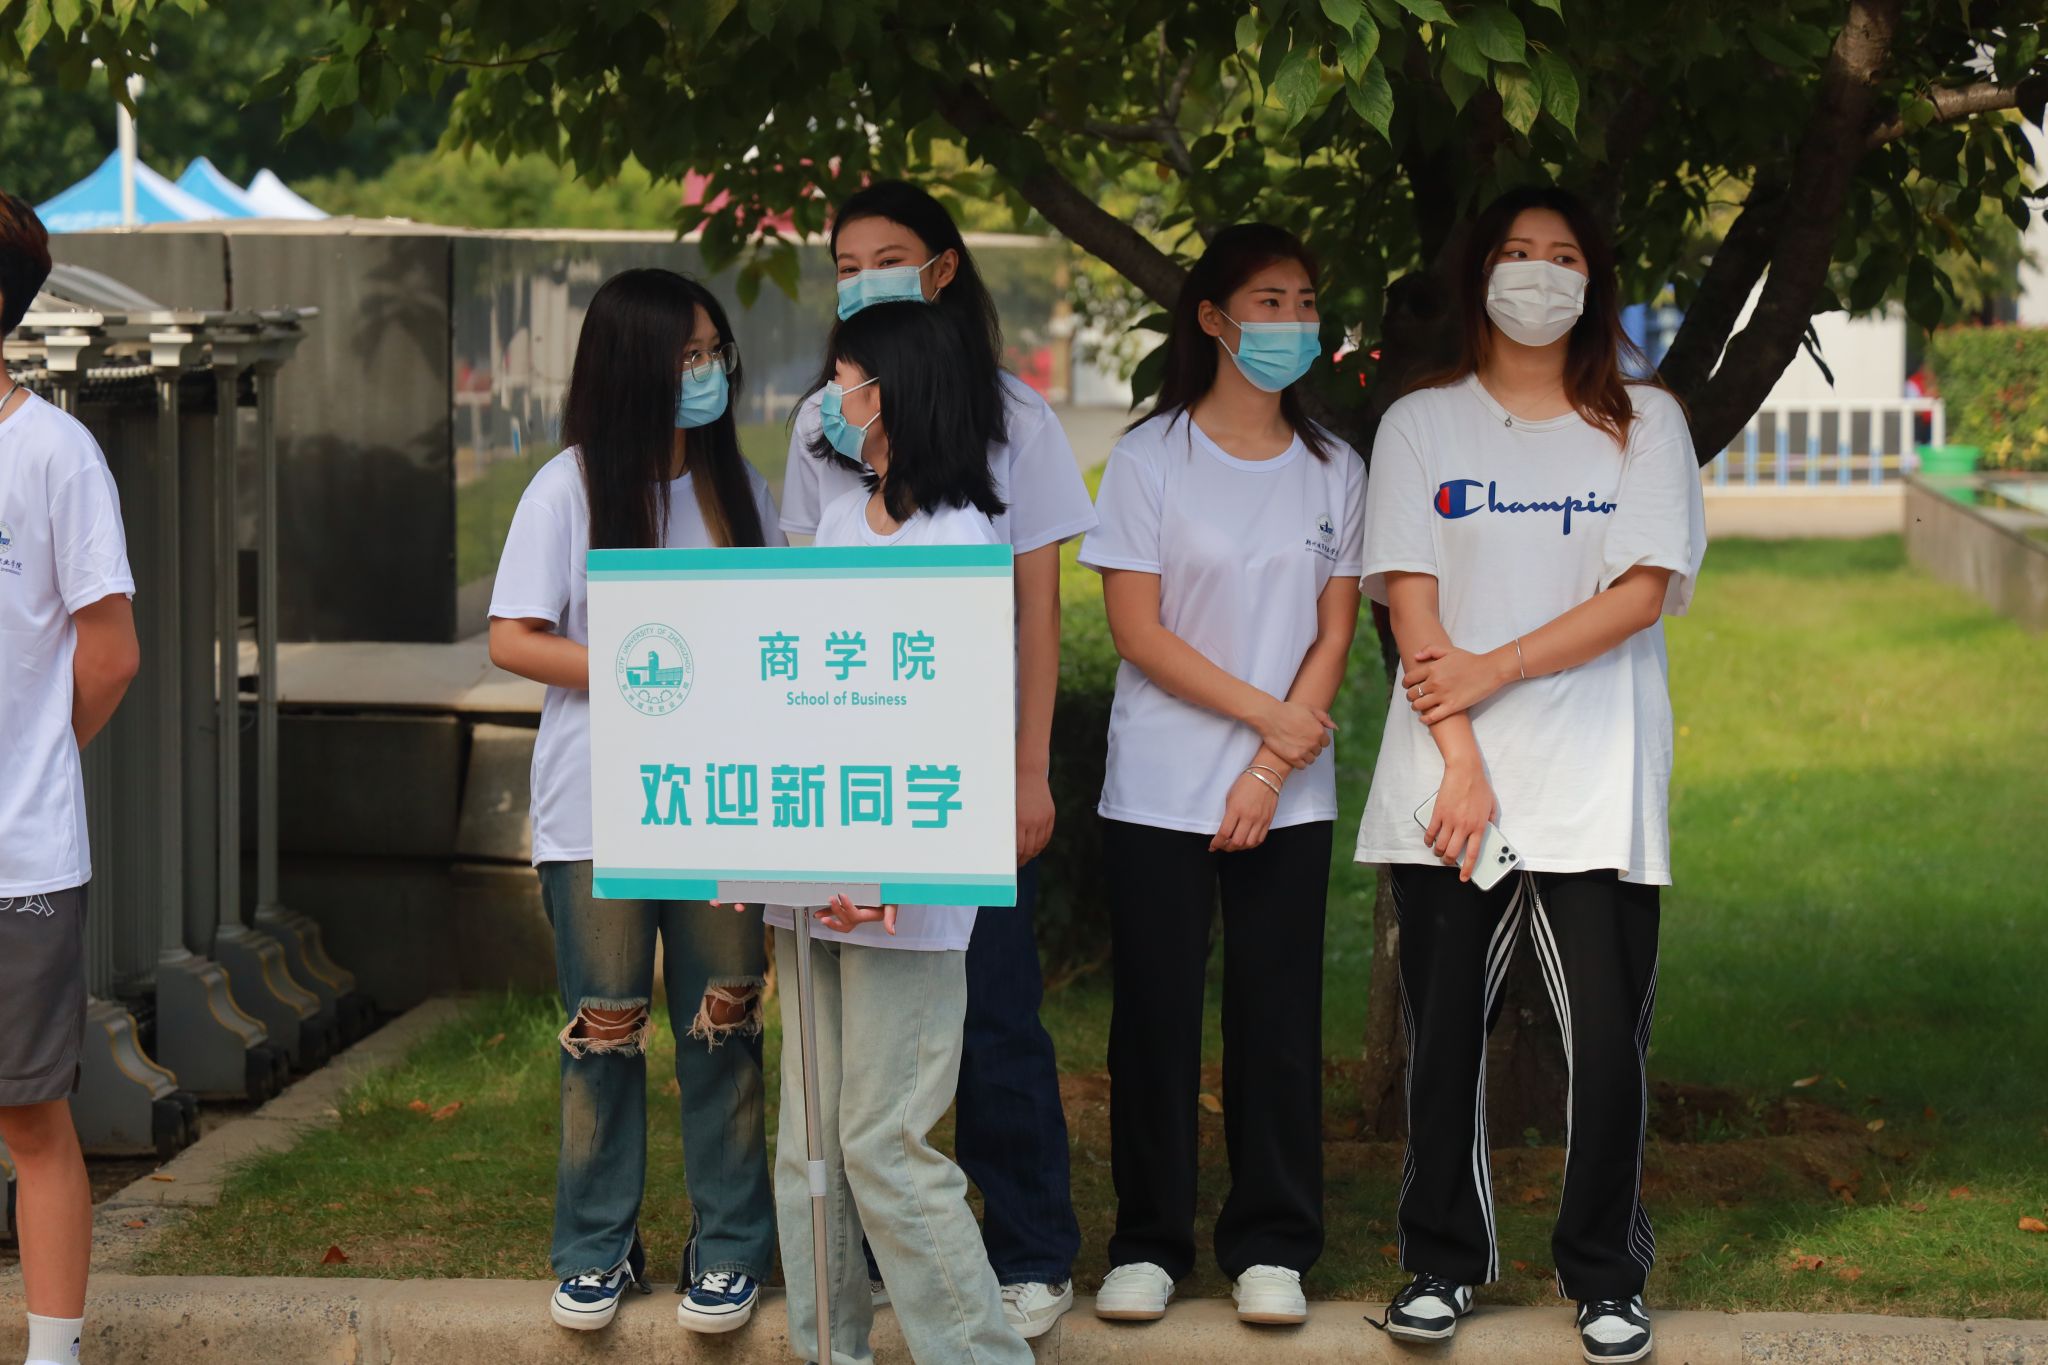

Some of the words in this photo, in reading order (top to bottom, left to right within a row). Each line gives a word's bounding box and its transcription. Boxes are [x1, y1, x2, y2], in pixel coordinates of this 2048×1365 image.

[1433, 479, 1618, 536] Champio
[623, 627, 654, 654] UNIVERSITY
[759, 630, 936, 682] 商学院
[786, 690, 829, 706] School
[833, 690, 847, 706] of
[851, 691, 907, 706] Business
[640, 763, 963, 829] 欢迎新同学
